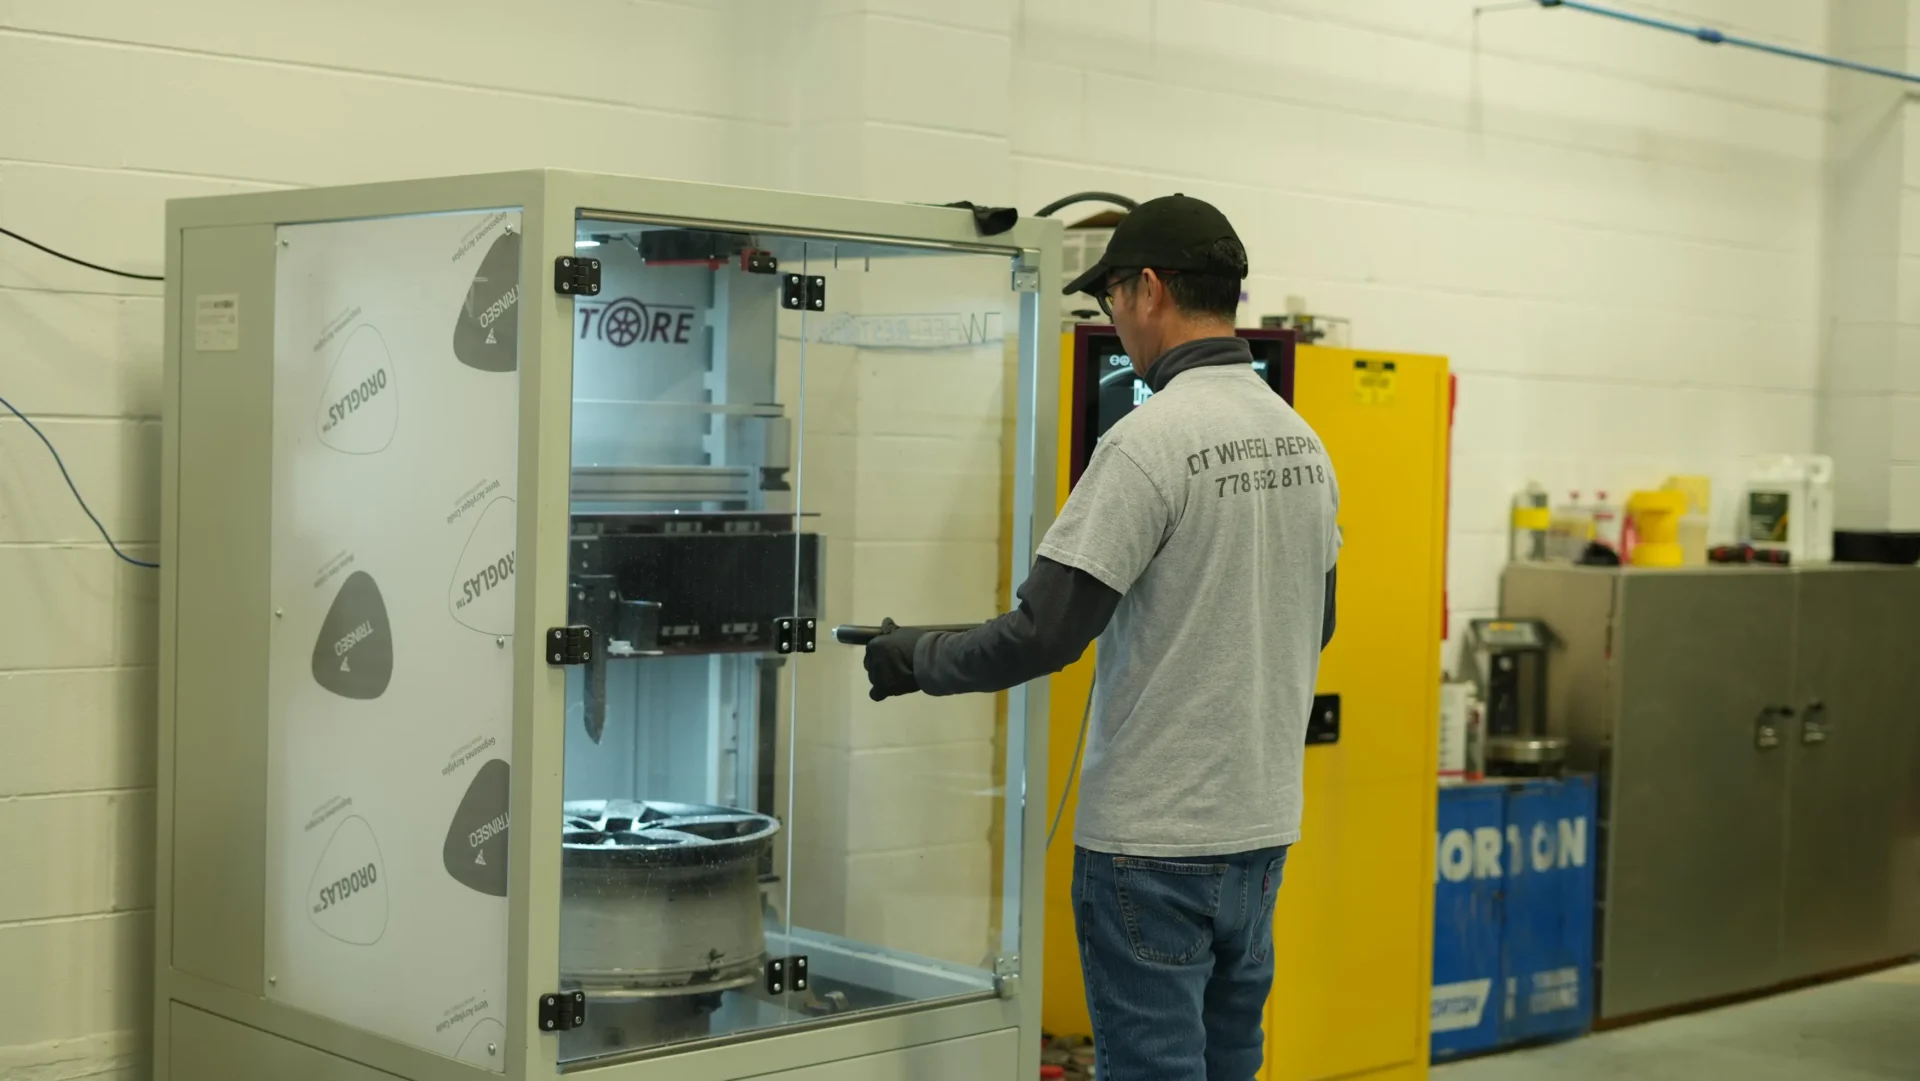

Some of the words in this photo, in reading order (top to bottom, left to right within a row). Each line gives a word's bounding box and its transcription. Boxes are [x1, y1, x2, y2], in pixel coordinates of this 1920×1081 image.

[480, 284, 519, 329] TRINSEO
[1186, 448, 1210, 476] DT
[1214, 438, 1272, 465] WHEEL
[1275, 436, 1318, 457] REPA
[1215, 473, 1251, 498] 778
[1253, 469, 1278, 491] 552
[1281, 465, 1325, 488] 8118
[334, 620, 373, 656] TRINSEO
[468, 811, 509, 847] TRINSEO
[1435, 816, 1587, 884] ORTON
